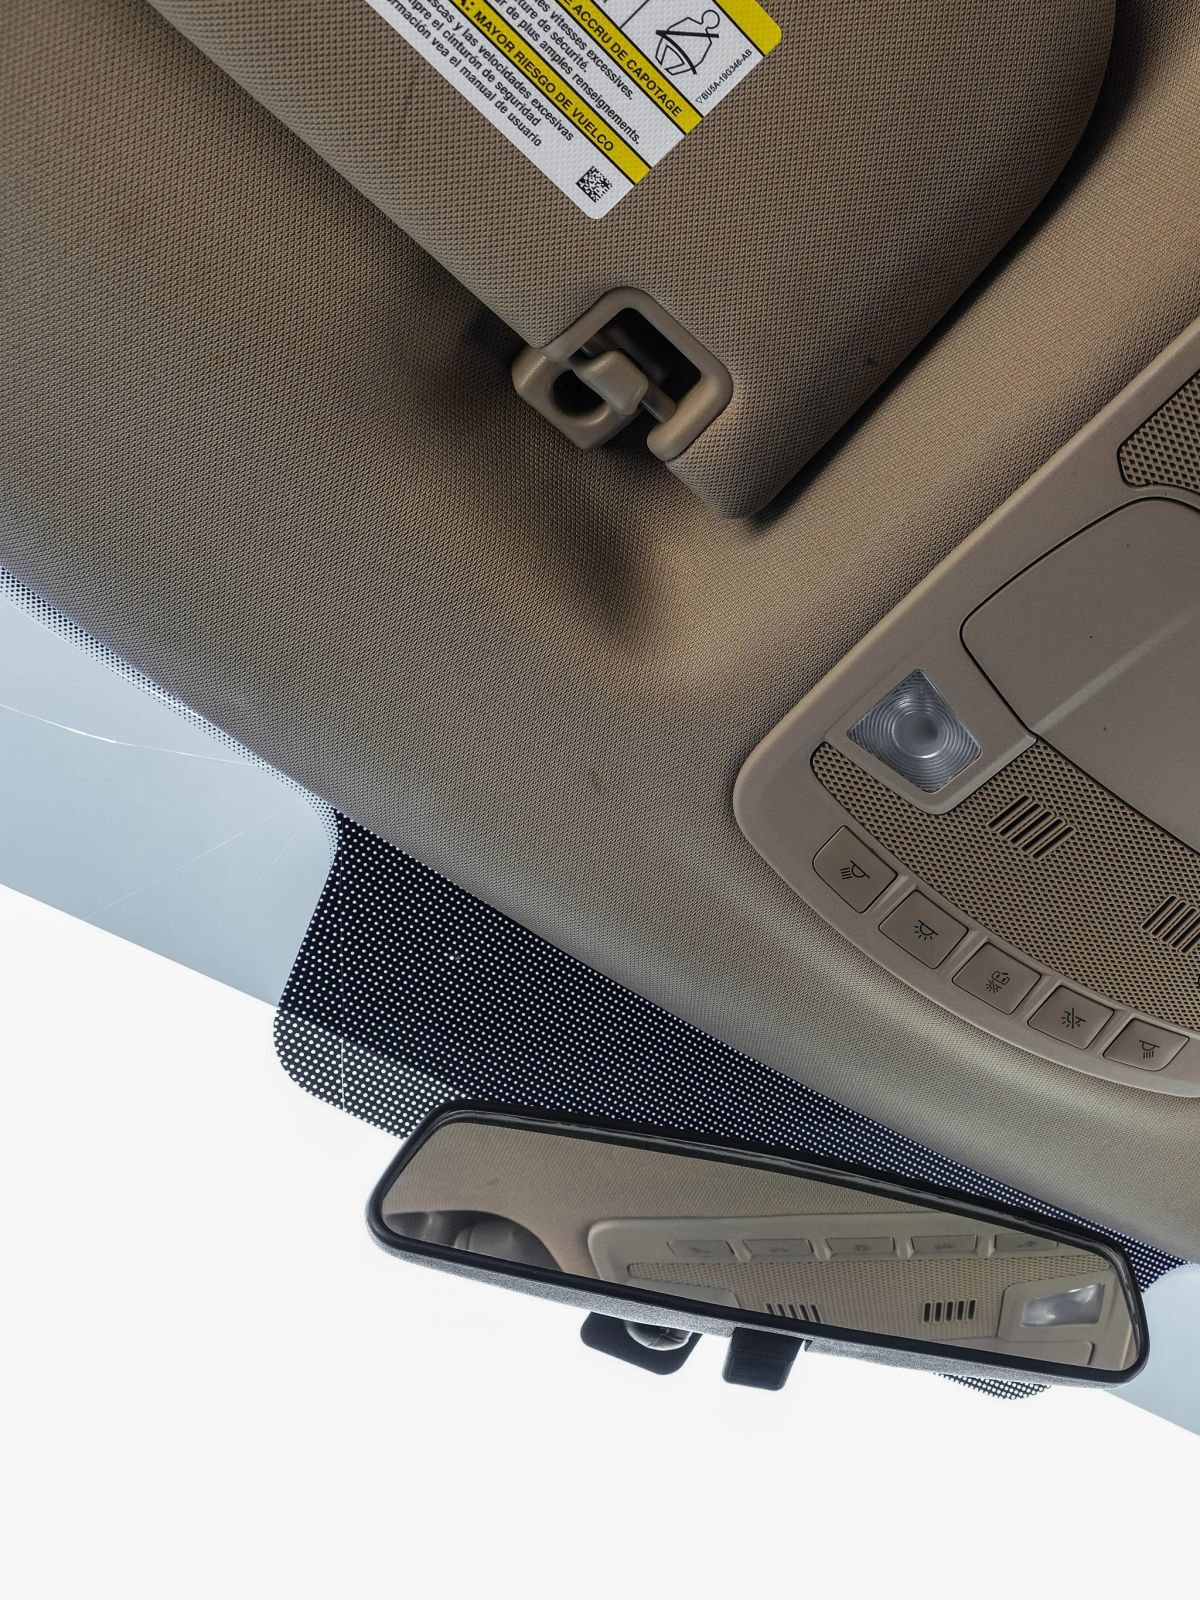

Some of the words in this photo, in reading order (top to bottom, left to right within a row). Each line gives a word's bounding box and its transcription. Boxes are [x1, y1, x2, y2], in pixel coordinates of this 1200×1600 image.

[390, 0, 431, 39] rmación
[431, 37, 450, 57] vea
[449, 55, 462, 68] el
[459, 66, 497, 101] manual
[494, 100, 508, 114] de
[507, 112, 542, 146] usuario
[428, 0, 455, 23] scas
[452, 21, 463, 31] y
[461, 28, 479, 47] las
[478, 45, 531, 99] velocidades
[531, 98, 574, 141] excesivas
[431, 19, 445, 31] el
[442, 30, 482, 70] cinturón
[481, 68, 496, 83] de
[495, 81, 541, 126] seguridad
[474, 10, 515, 53] MAYOR
[513, 50, 556, 93] RIESGO
[554, 91, 573, 111] DE
[572, 107, 614, 151] VUELCO
[505, 6, 520, 21] de
[517, 19, 540, 42] plus
[539, 40, 573, 75] amples
[572, 74, 639, 144] renseignements.
[515, 0, 538, 19] ture
[537, 18, 551, 33] de
[550, 31, 588, 72] sécurité.
[550, 11, 587, 50] vitesses
[586, 49, 633, 100] excessives.
[572, 4, 612, 44] ACCRU
[609, 42, 628, 61] DE
[626, 59, 682, 117] CAPOTAGE
